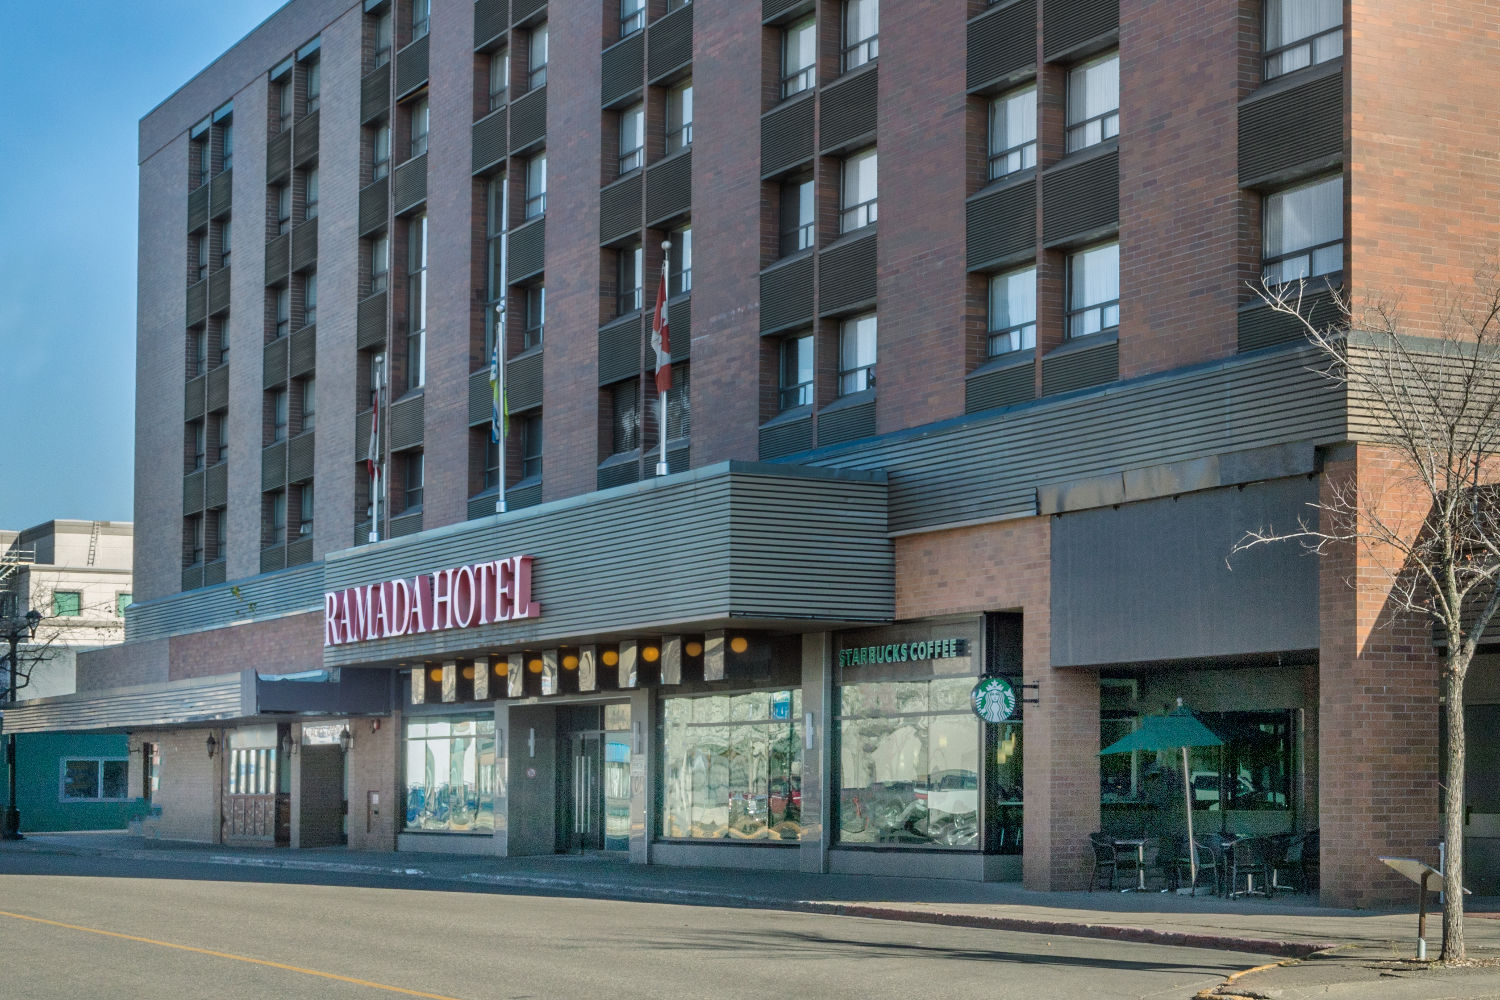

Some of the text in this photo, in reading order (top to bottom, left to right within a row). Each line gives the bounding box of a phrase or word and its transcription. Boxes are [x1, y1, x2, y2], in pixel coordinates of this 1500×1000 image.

[324, 555, 535, 647] RAMADA HOTEL
[839, 638, 957, 668] STARBUCKS COFFEE
